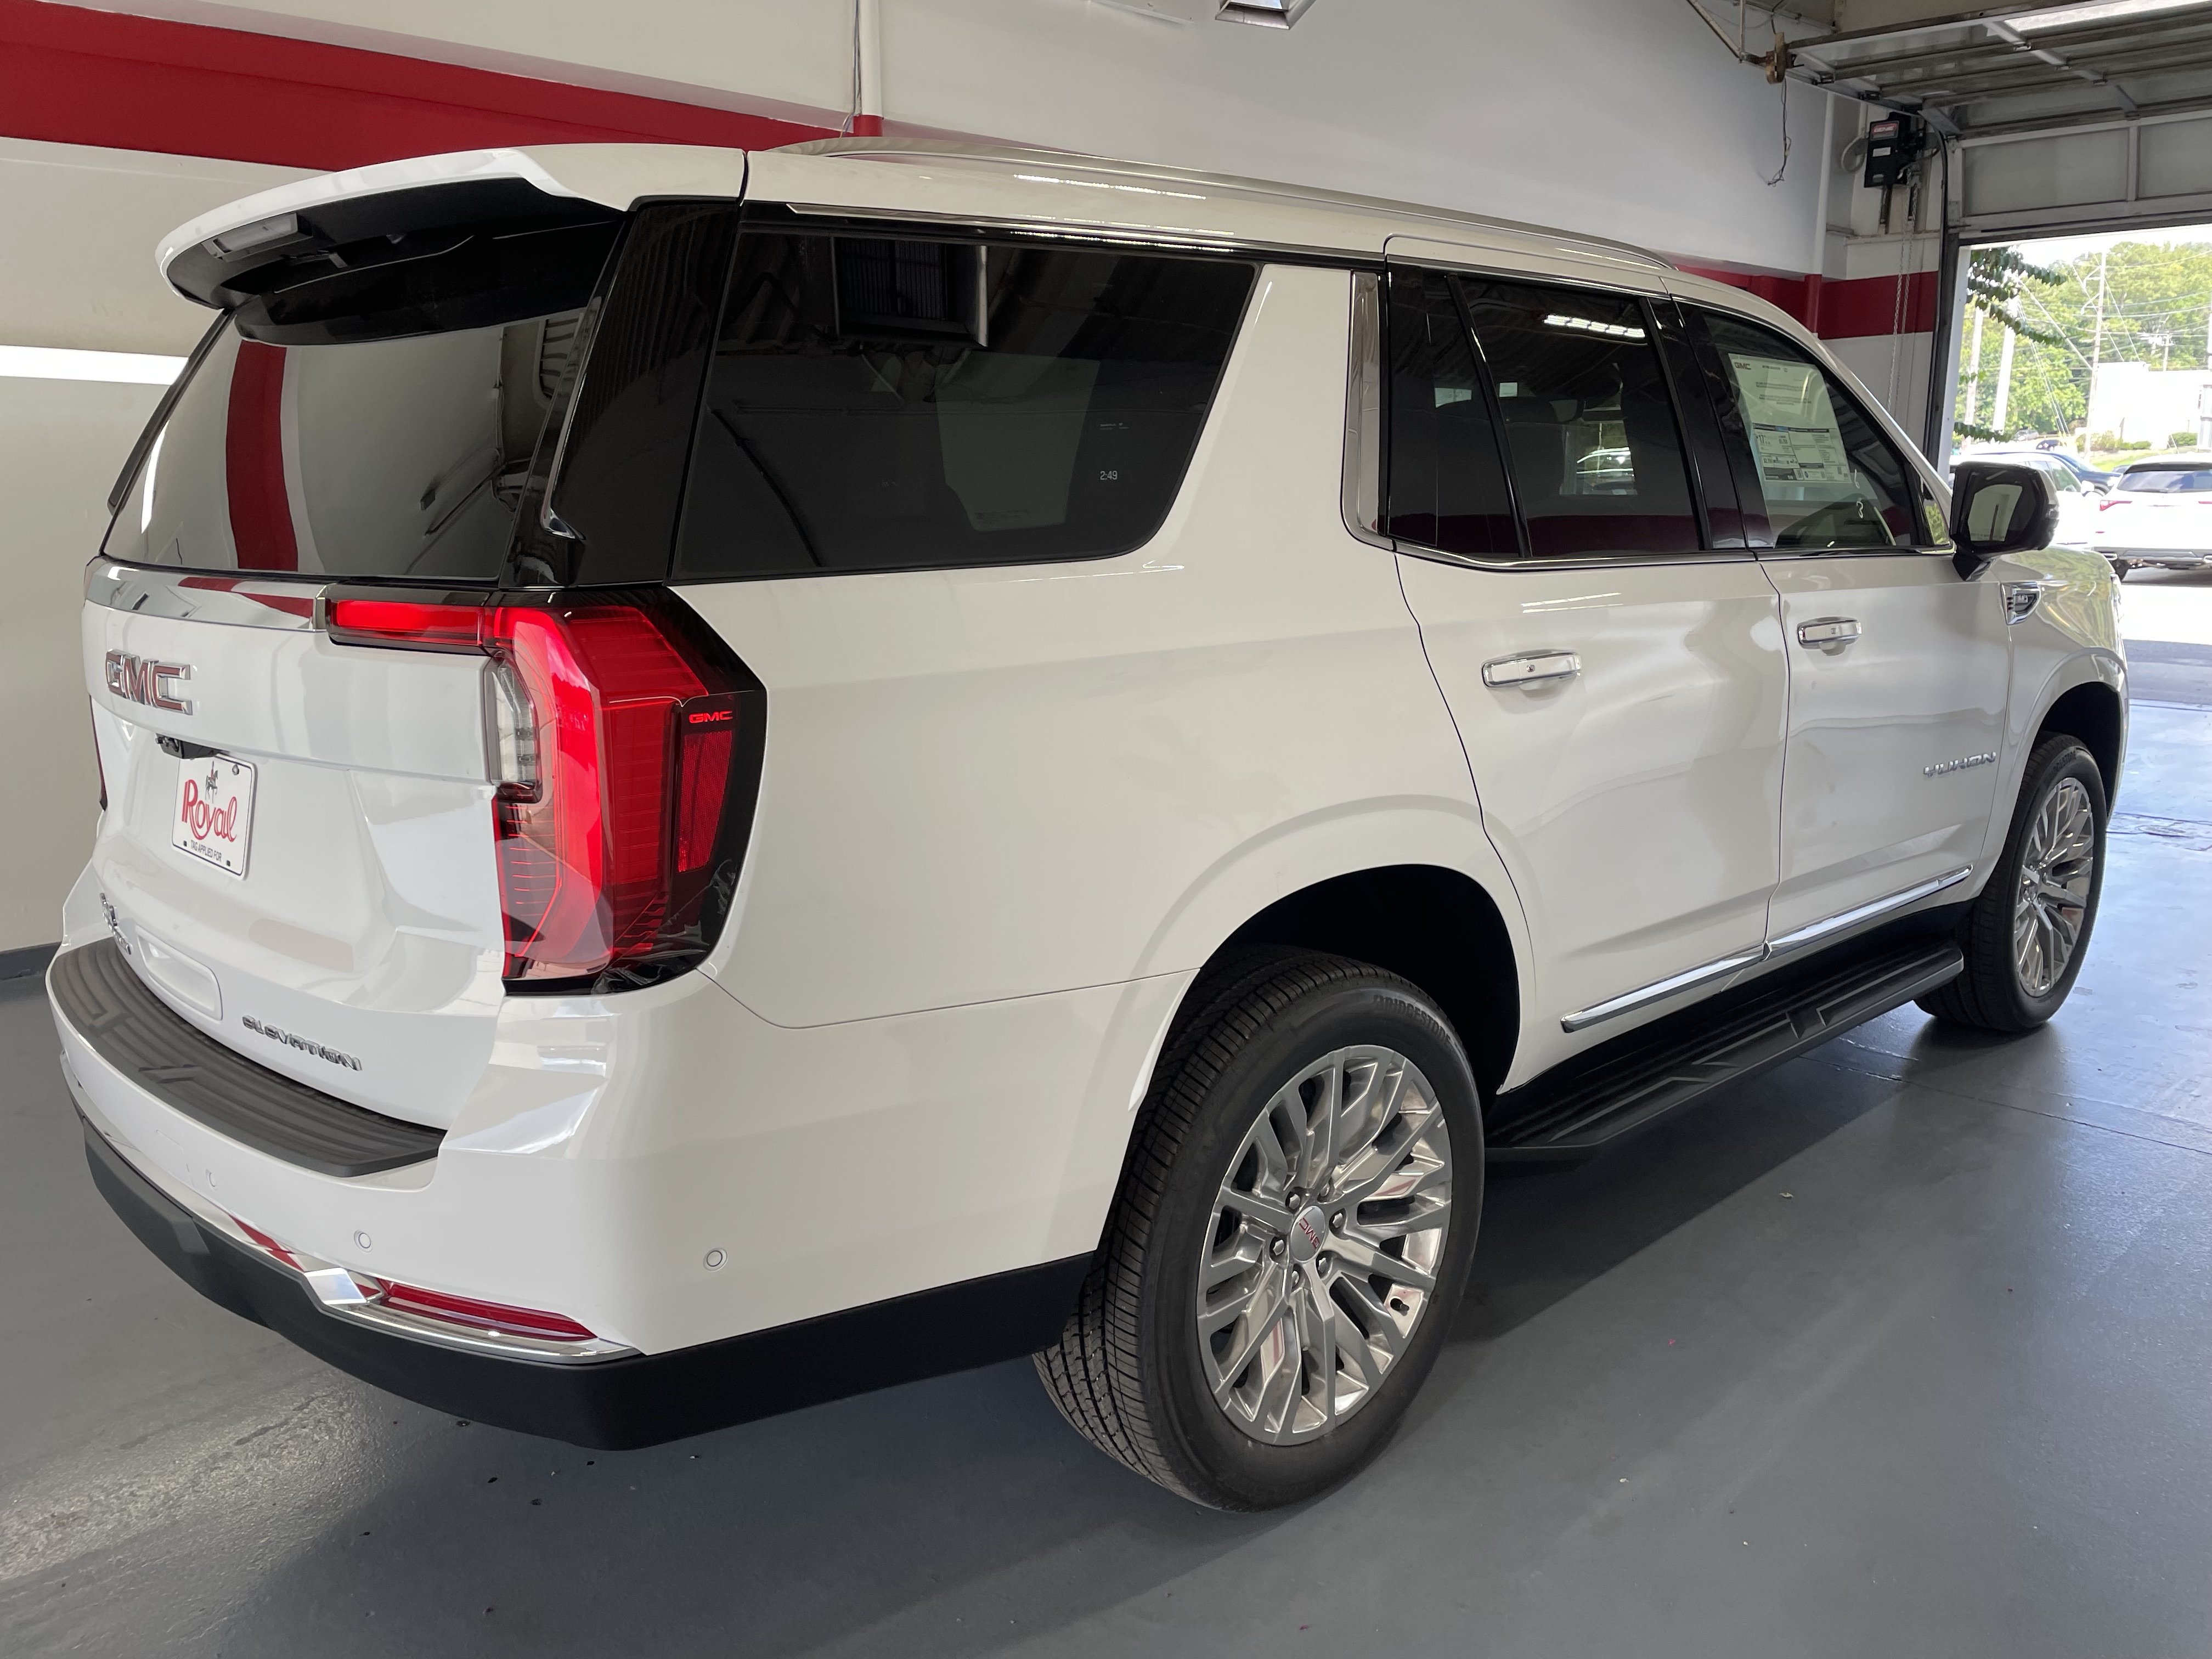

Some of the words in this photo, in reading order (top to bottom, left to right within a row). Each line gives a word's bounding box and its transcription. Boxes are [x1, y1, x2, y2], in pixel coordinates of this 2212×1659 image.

[1734, 362, 1752, 370] GMC
[1100, 470, 1118, 481] 2:49
[105, 648, 193, 715] GMC
[689, 710, 733, 724] GMC
[1923, 752, 1996, 777] YUKON
[182, 779, 237, 843] Royal
[198, 843, 213, 859] APPLIED
[213, 849, 222, 862] FOR
[242, 1014, 362, 1071] ELEVATION
[1298, 1217, 1320, 1249] GMC
